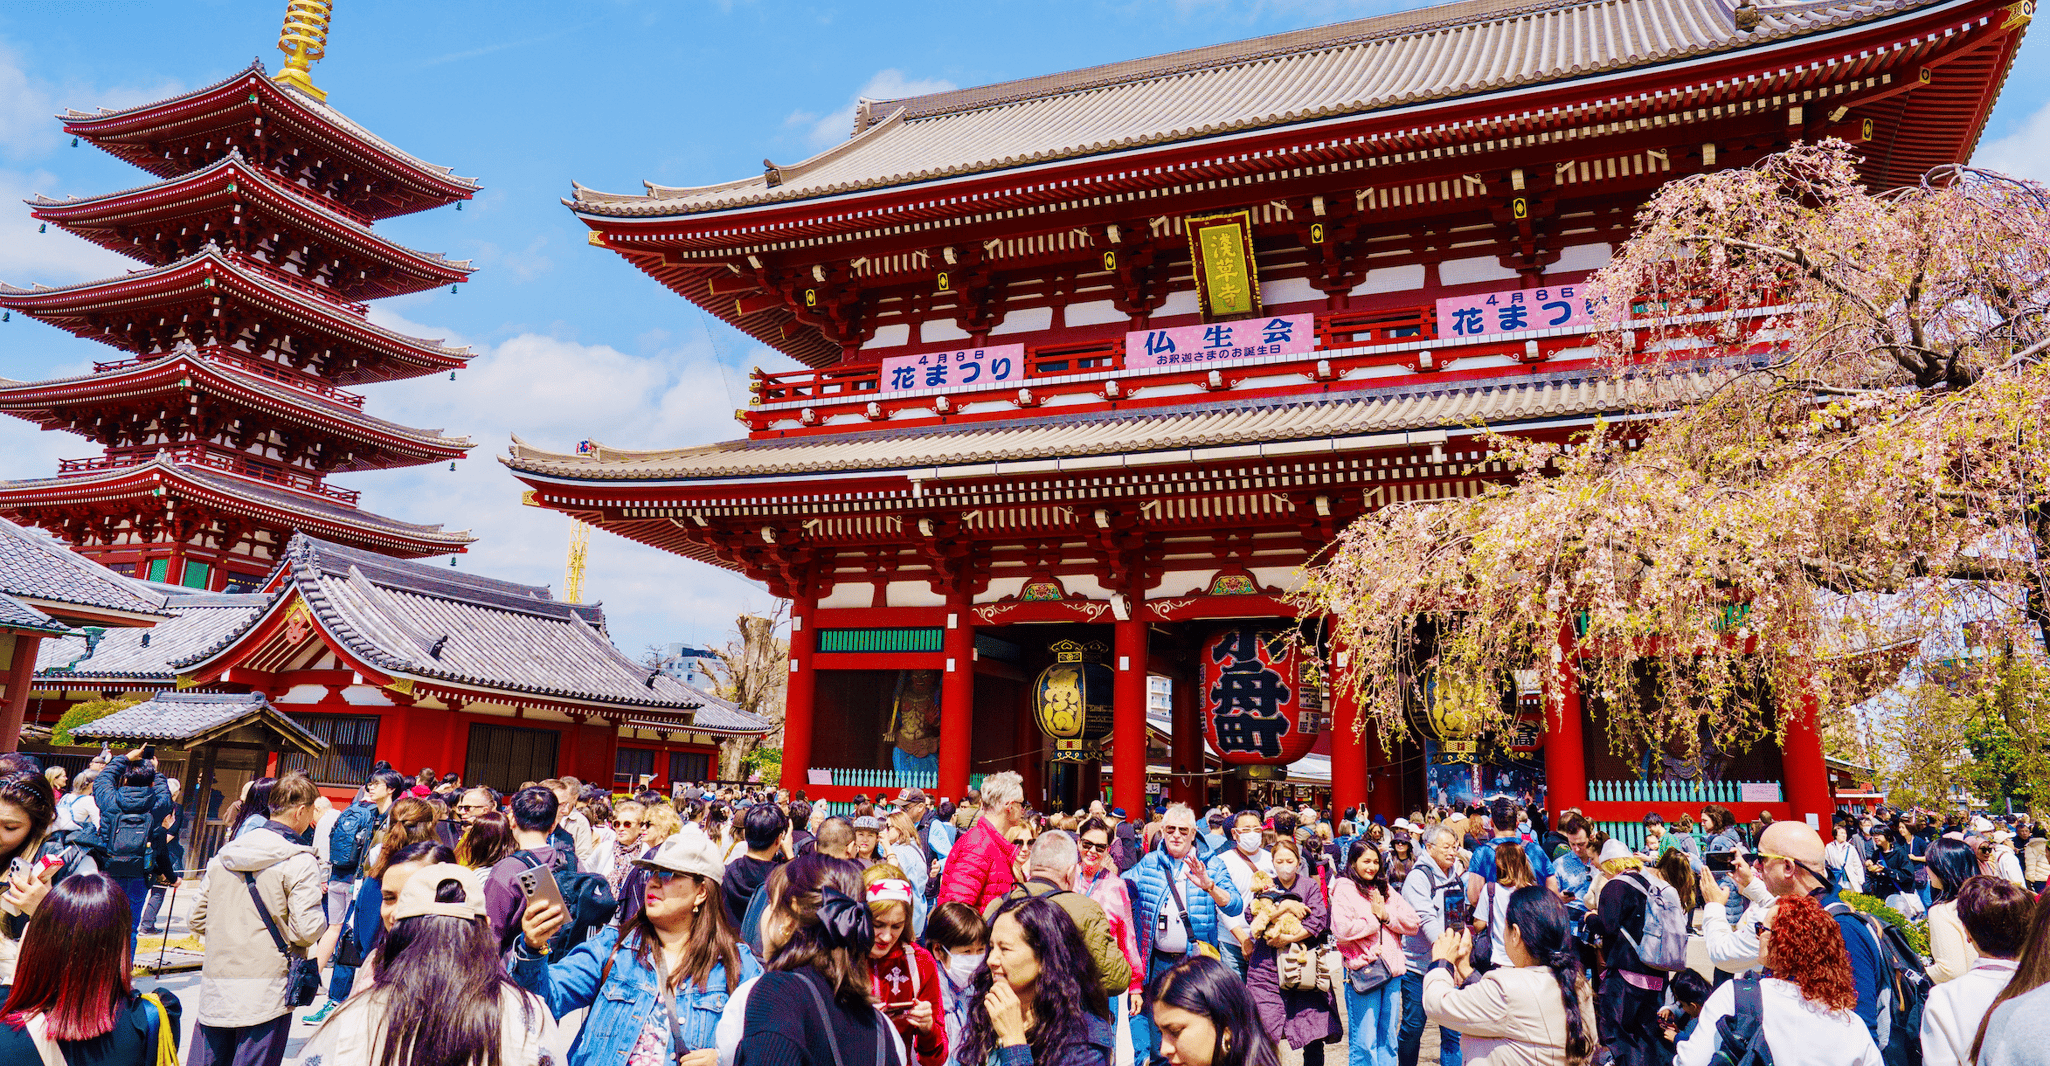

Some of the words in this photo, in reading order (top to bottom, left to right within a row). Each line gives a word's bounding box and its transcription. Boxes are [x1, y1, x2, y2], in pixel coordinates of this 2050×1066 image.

[1486, 287, 1574, 307] 4月8日
[1144, 318, 1294, 356] 仏生会
[918, 350, 985, 365] 4月8日
[1157, 344, 1281, 365] お釈迦さまのお誕生日
[891, 357, 1011, 390] 花まつり
